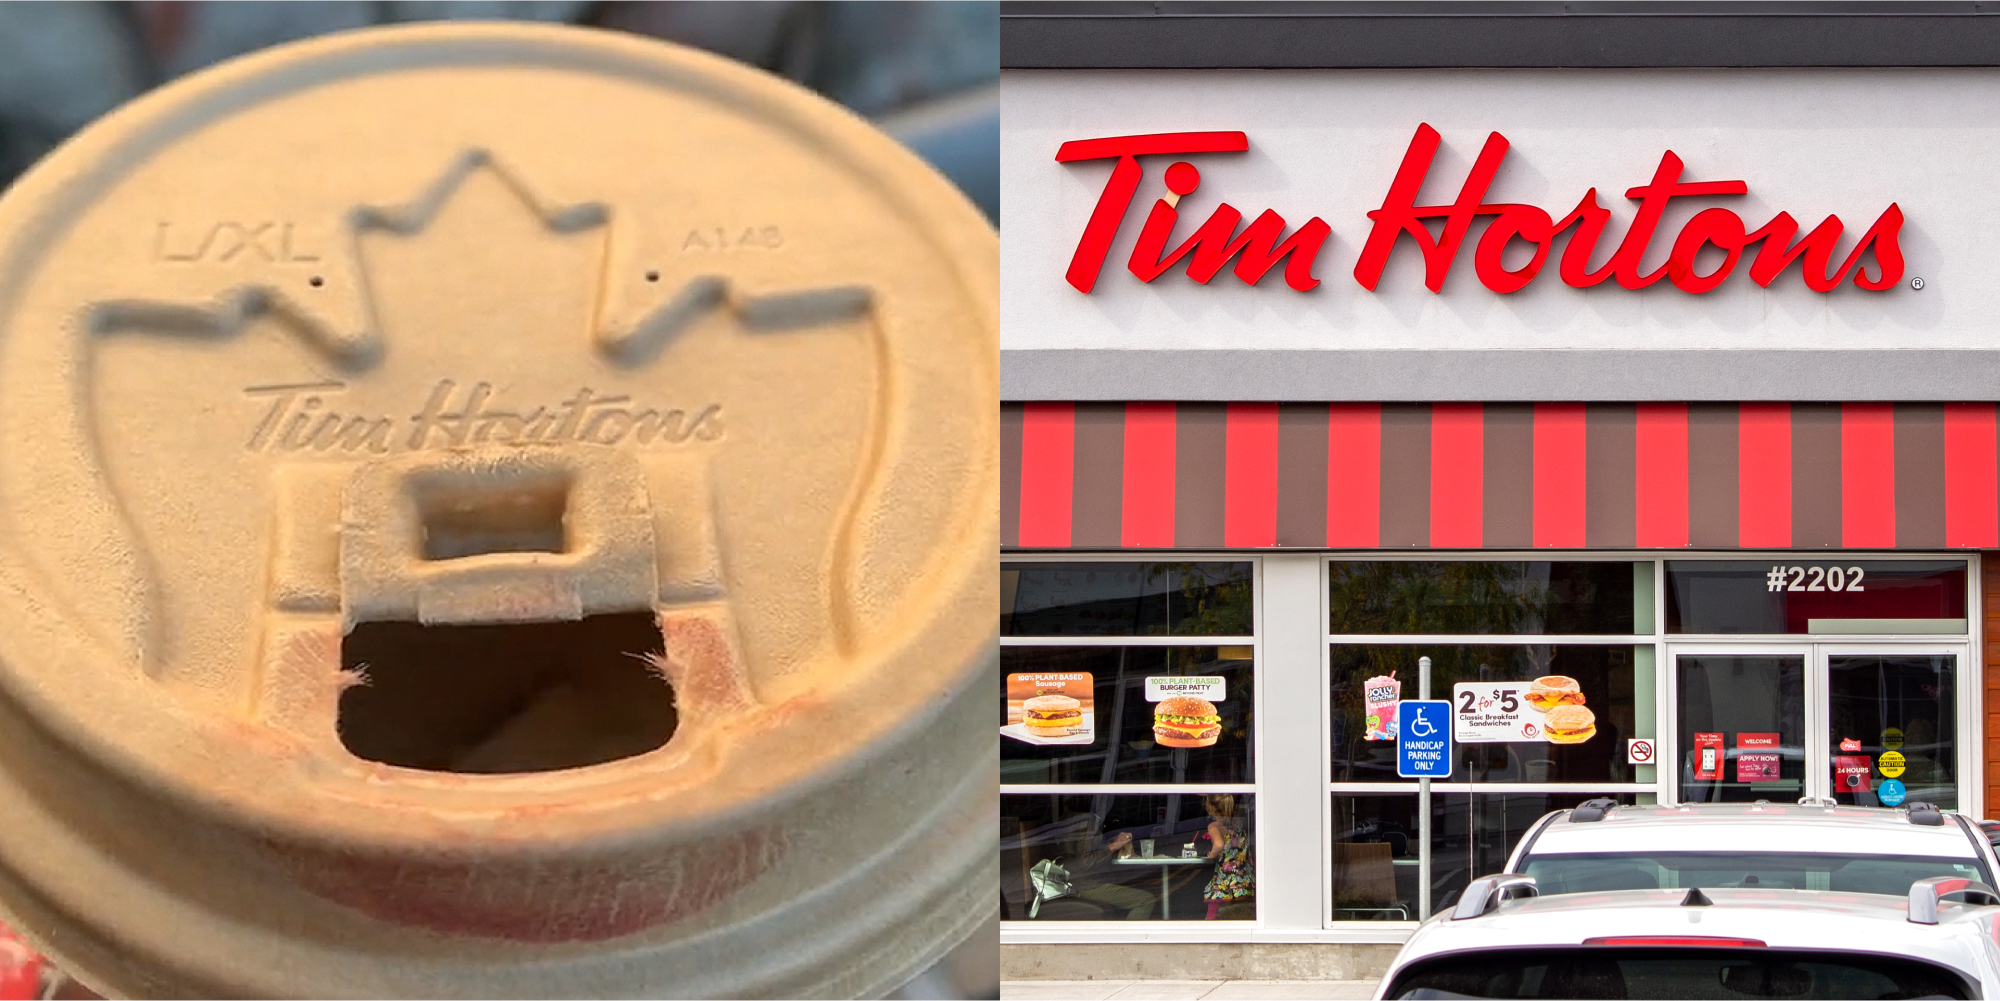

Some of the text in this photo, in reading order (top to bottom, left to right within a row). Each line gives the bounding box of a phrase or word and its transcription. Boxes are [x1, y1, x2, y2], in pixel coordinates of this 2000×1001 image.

[1055, 131, 1332, 295] Tim
[1353, 122, 1906, 295] Hortons
[152, 221, 323, 263] L/XL
[243, 377, 726, 455] Tim Hortons
[1766, 565, 1865, 592] #2202
[1035, 673, 1084, 681] PLANT-BASED
[1169, 677, 1221, 685] PLANT-BASED
[1035, 680, 1066, 688] Sausage
[1368, 686, 1394, 698] JOLLY
[1369, 693, 1397, 702] rancher
[1459, 691, 1476, 713] 2
[1478, 696, 1494, 712] for
[1370, 700, 1397, 710] SLUSHY
[1404, 741, 1444, 750] HANDICAP
[1408, 751, 1441, 760] PARKING
[1414, 761, 1434, 771] ONLY
